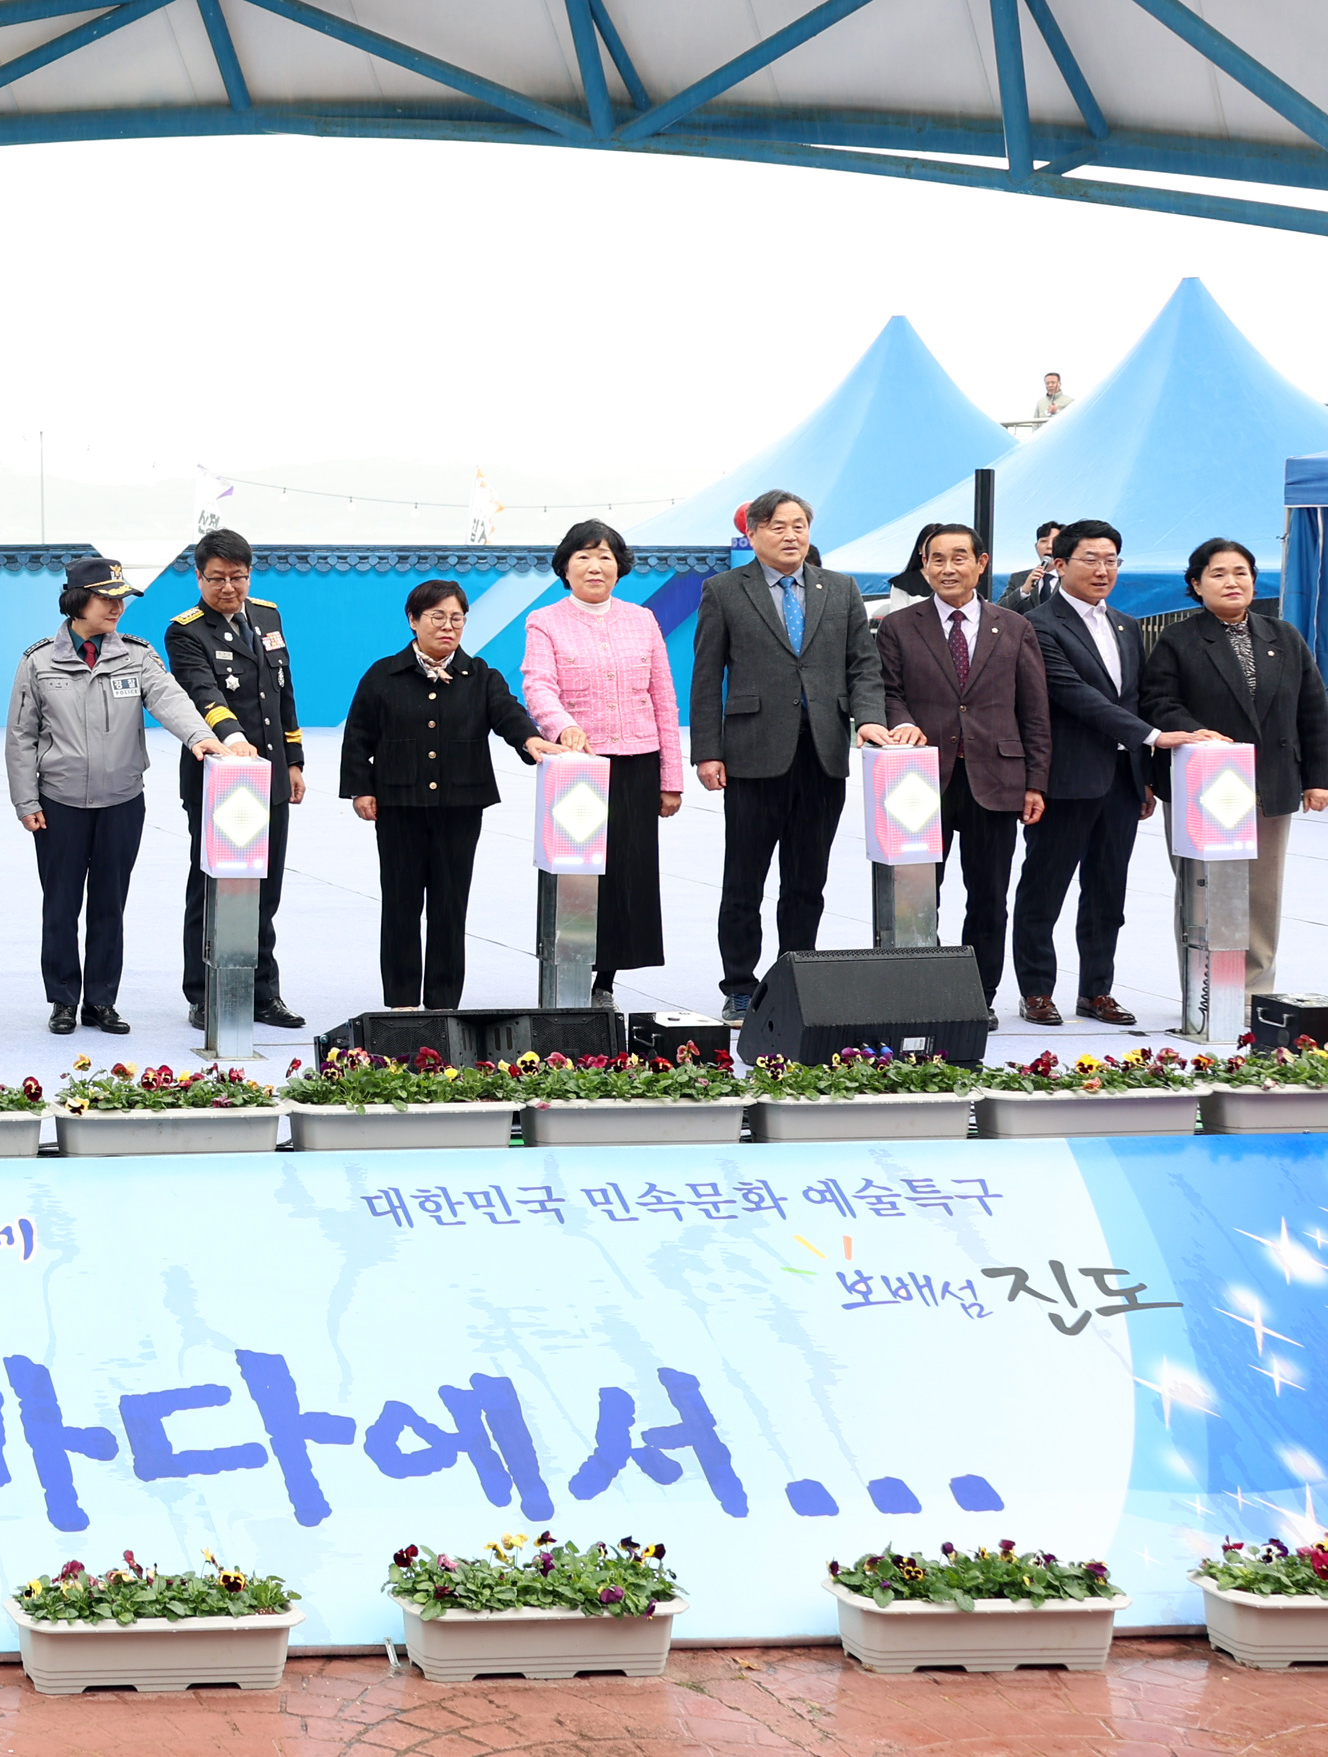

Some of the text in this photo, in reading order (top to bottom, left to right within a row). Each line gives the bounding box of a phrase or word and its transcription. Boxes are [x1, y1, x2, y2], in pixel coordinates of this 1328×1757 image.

[360, 1178, 1004, 1229] 대한민국 민속문화 예술특구
[836, 1259, 1184, 1337] 보배섬 진도
